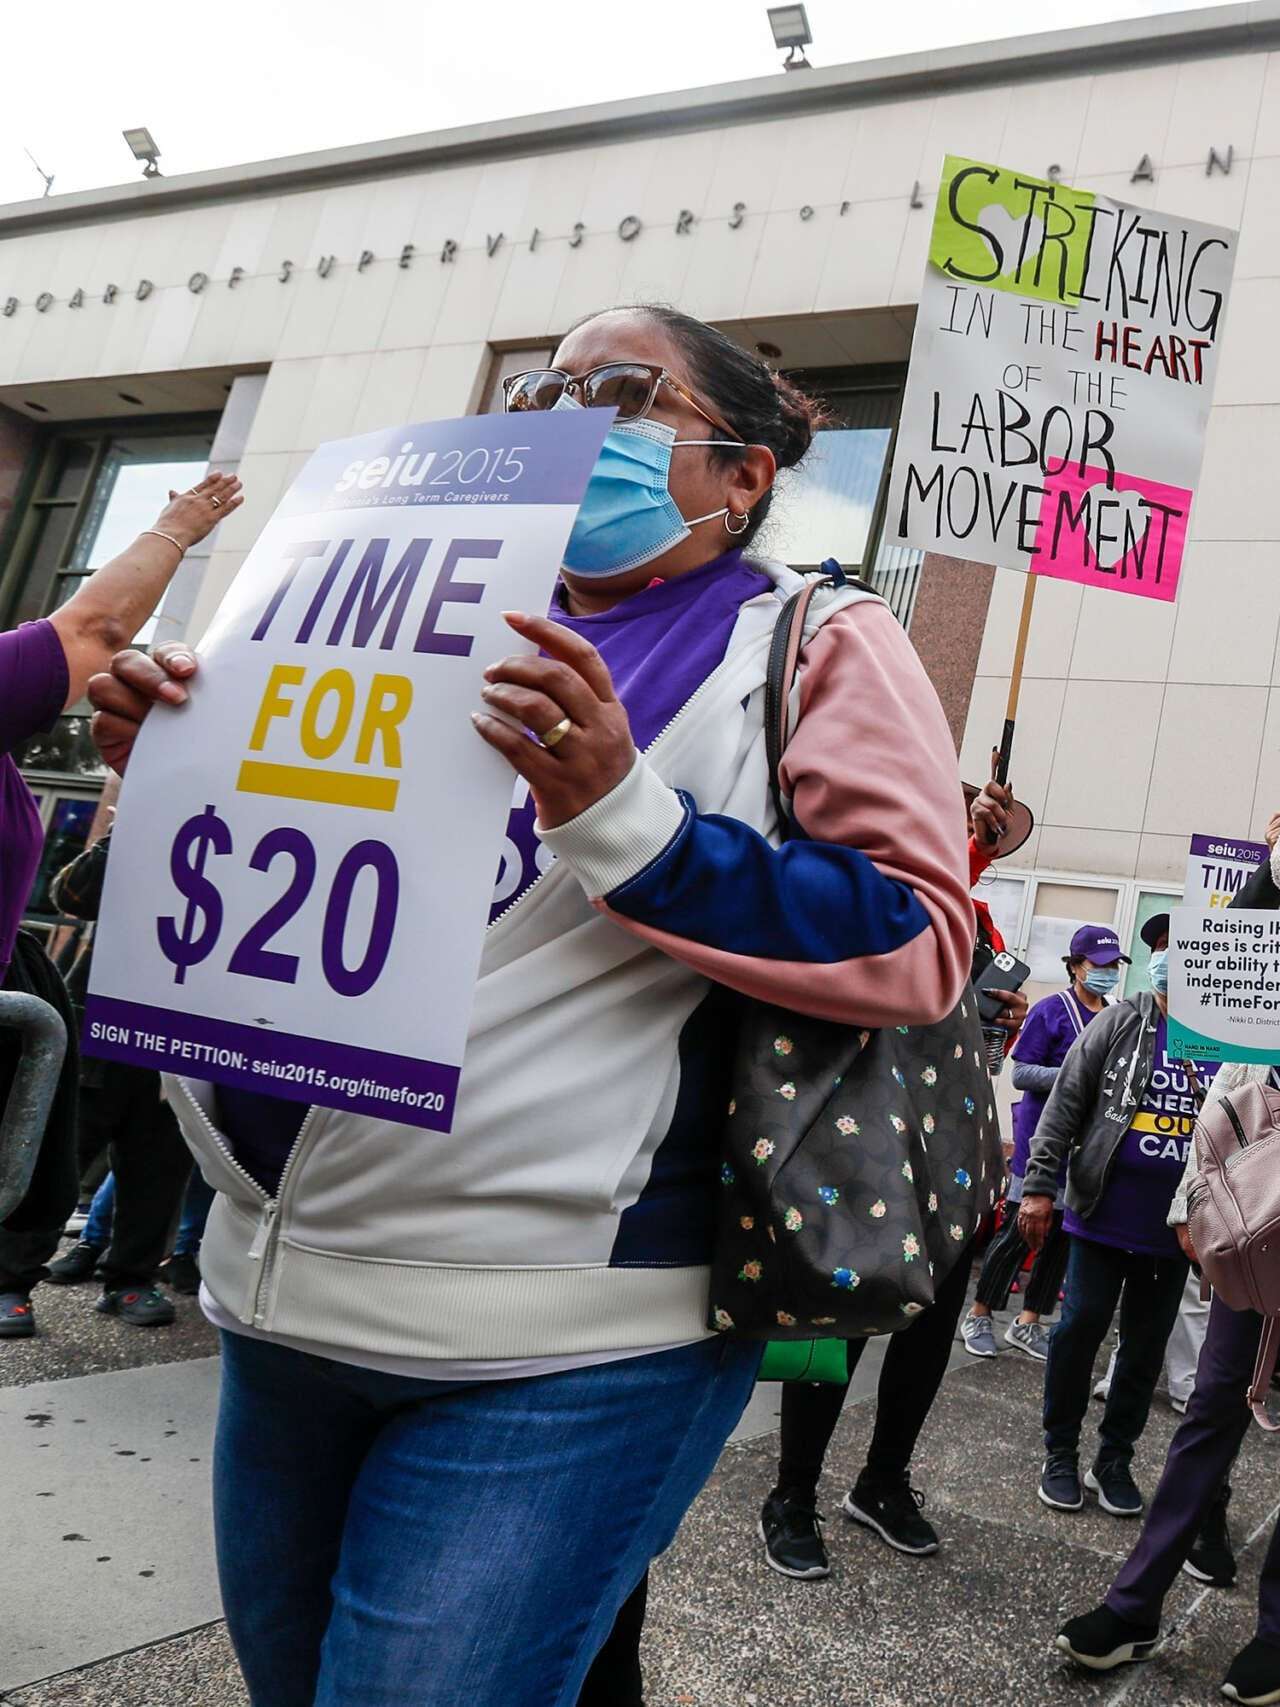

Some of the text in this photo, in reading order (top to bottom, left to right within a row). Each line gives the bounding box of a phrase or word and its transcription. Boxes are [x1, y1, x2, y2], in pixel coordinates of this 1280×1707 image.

[3, 279, 153, 317] BOARD
[187, 266, 244, 294] OF
[278, 202, 747, 284] SUPERVISORS
[800, 200, 851, 222] OF
[910, 164, 1062, 208] LS
[943, 166, 1229, 342] STRIKING
[940, 286, 1211, 384] IN THE HEART
[1003, 364, 1128, 410] OF THE
[931, 389, 1115, 491] LABOR
[414, 493, 441, 503] Term
[444, 490, 511, 502] Caregivers
[898, 463, 1183, 584] MOVEMENT
[250, 537, 505, 657] TIME
[247, 664, 415, 769] FOR
[156, 804, 401, 998] $20
[1177, 940, 1230, 955] wages
[1234, 938, 1247, 952] is
[1202, 919, 1264, 939] Raising
[1184, 959, 1212, 969] our
[1216, 956, 1268, 976] ability
[90, 1022, 445, 1112] SIGN THE PETTION: seiu2015.org/timefor20
[1256, 1018, 1280, 1026] District
[1104, 1106, 1128, 1124] East
